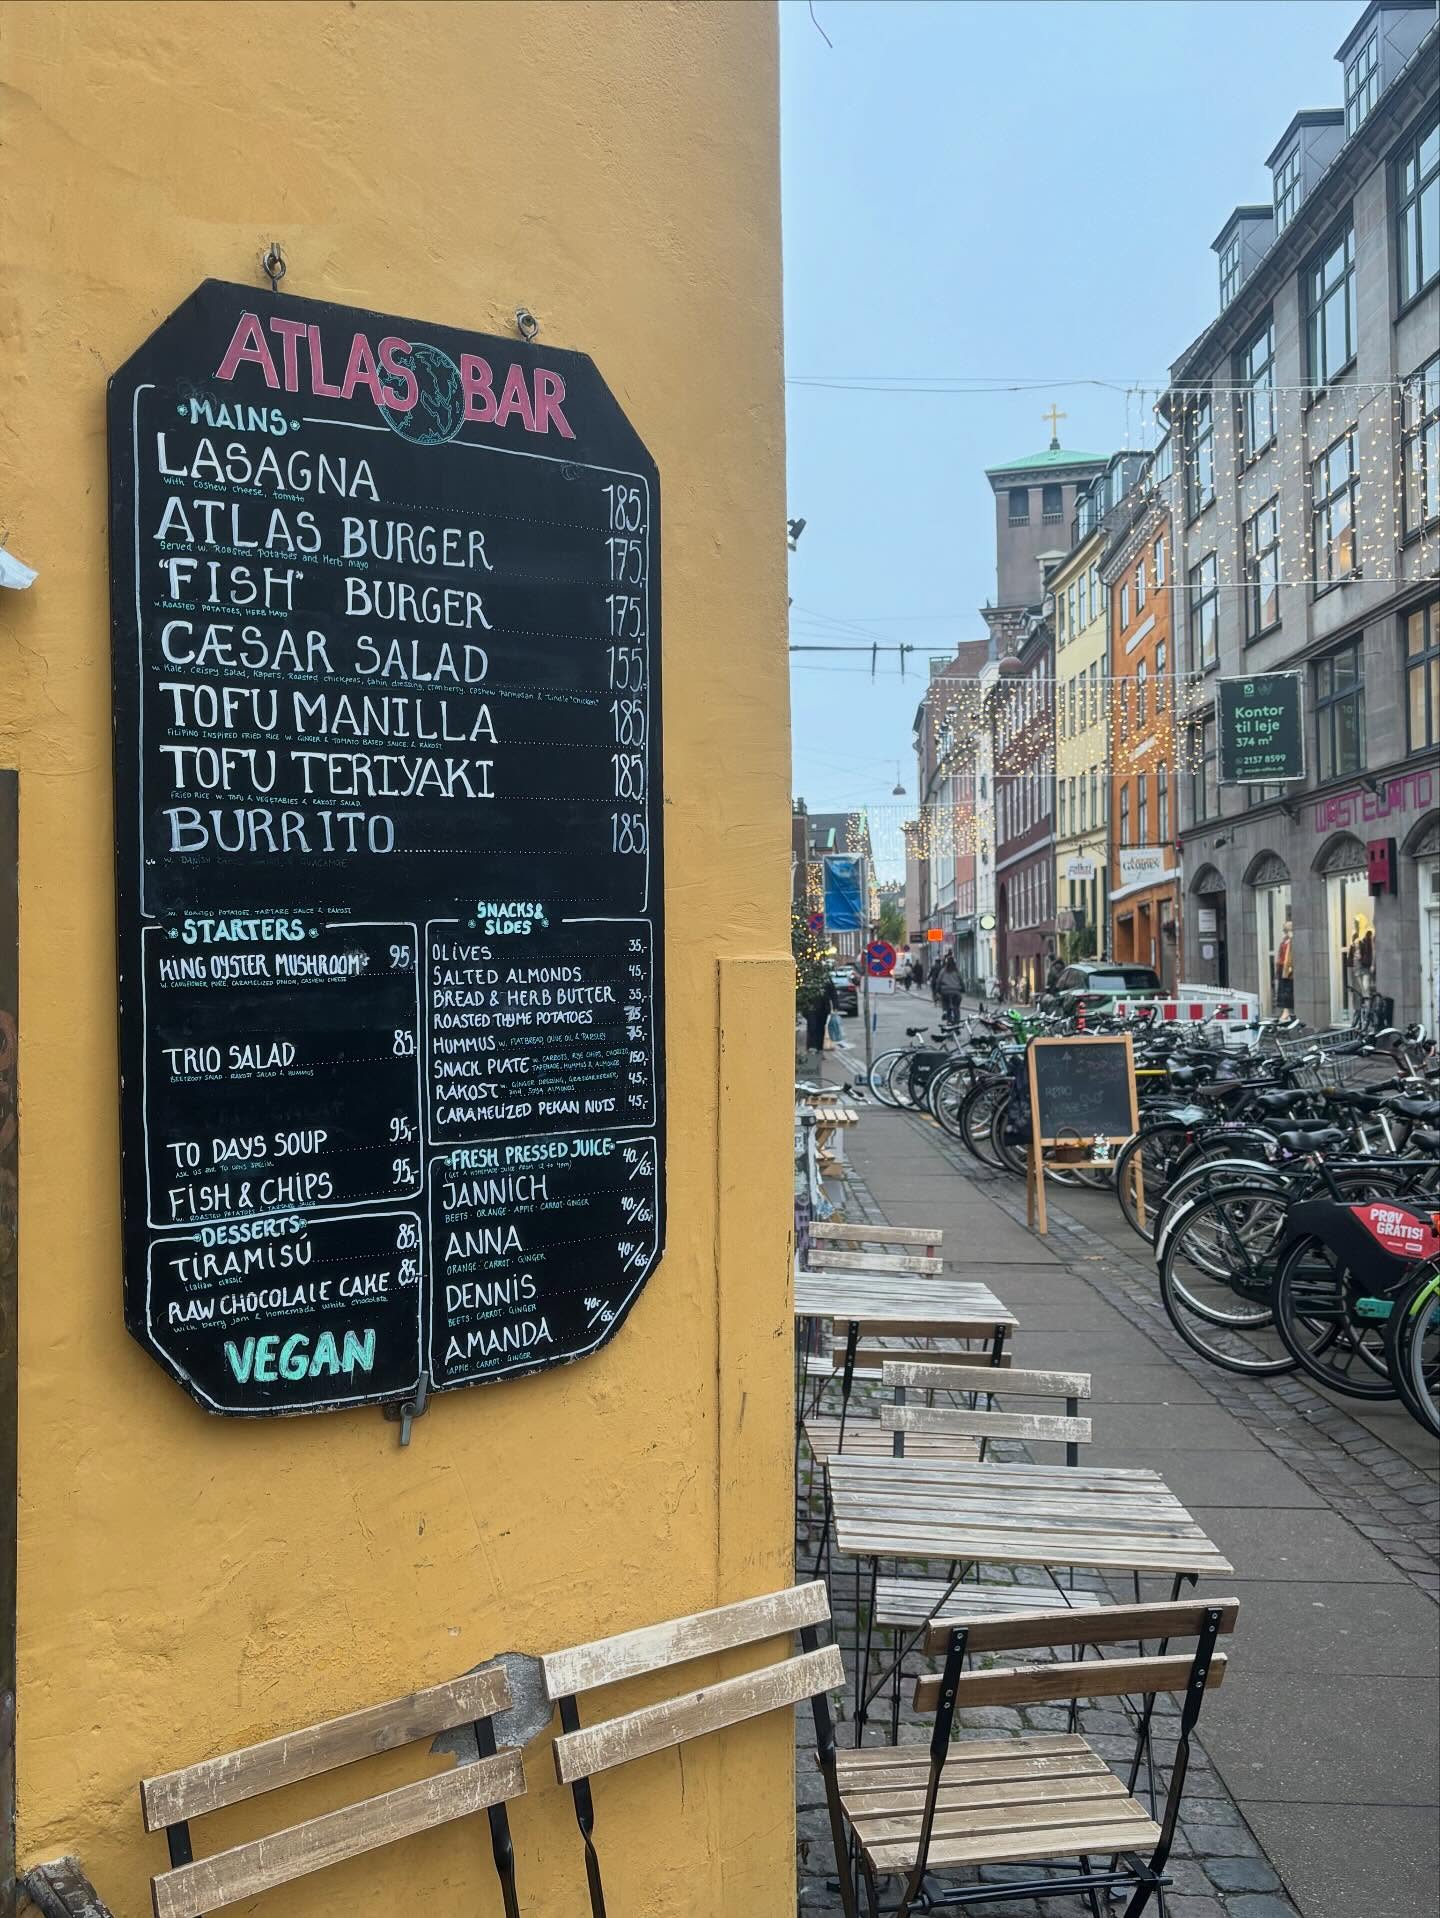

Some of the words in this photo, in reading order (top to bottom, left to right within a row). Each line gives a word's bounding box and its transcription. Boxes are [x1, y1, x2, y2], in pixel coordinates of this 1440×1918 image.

[216, 312, 418, 411] ATLAS
[461, 353, 576, 440] BAR
[190, 398, 287, 436] MAINS
[157, 432, 380, 501] LASAGNA
[153, 497, 321, 552] ATLAS
[341, 517, 494, 571] BURGER
[163, 600, 196, 611] ROASTED
[345, 577, 493, 629] BURGER
[161, 620, 334, 672] CÆSAR
[355, 635, 488, 683] SALAD
[159, 682, 278, 730] TOFU
[293, 691, 498, 744] MANILLA
[1235, 706, 1284, 719] Kontor
[1235, 721, 1251, 733] til
[1255, 719, 1280, 734] leje
[1236, 737, 1255, 748] 374
[159, 745, 276, 792] TOFU
[291, 751, 495, 799] TERIYAKI
[163, 807, 394, 853] BURRITO
[182, 918, 305, 945] STARTERS
[211, 953, 270, 979] OYSTER
[433, 965, 499, 986] SALTED
[506, 966, 582, 984] ALMONDS
[433, 991, 485, 1007] BREAD
[489, 991, 500, 1006] &
[507, 989, 552, 1005] HERB
[557, 986, 616, 1004] BUTTER
[434, 1013, 490, 1029] ROASTED
[493, 1013, 532, 1028] THYME
[536, 1010, 593, 1025] POTATOES
[433, 1036, 495, 1055] HUMMUS
[162, 1046, 221, 1076] TRIO
[229, 1043, 296, 1070] SALAD
[434, 1060, 481, 1079] SNACK
[436, 1082, 498, 1101] RÅKOST
[539, 1101, 579, 1116] PEKAN
[585, 1098, 616, 1113] NUTS
[167, 1143, 199, 1169] TO
[213, 1136, 267, 1164] DAYS
[274, 1130, 327, 1157] SOUP
[451, 1148, 499, 1170] FRESH
[505, 1142, 568, 1164] PRESSED
[570, 1138, 611, 1158] JUICE
[239, 1182, 253, 1207] &
[445, 1212, 468, 1223] BEETS
[477, 1206, 506, 1218] ORANGE
[1370, 1208, 1403, 1224] PRØV
[201, 1215, 299, 1247] DESSERTS
[445, 1225, 523, 1261] ANNA
[1377, 1221, 1424, 1240] GRATIS!
[446, 1262, 476, 1276] ORANGE
[168, 1299, 215, 1324] RAW
[339, 1272, 390, 1297] CAKE
[448, 1315, 470, 1327] BEETS
[477, 1309, 502, 1320] CARROT
[445, 1317, 553, 1365] AMANDA
[224, 1328, 376, 1384] VEGAN
[477, 1358, 500, 1369] CARROT
